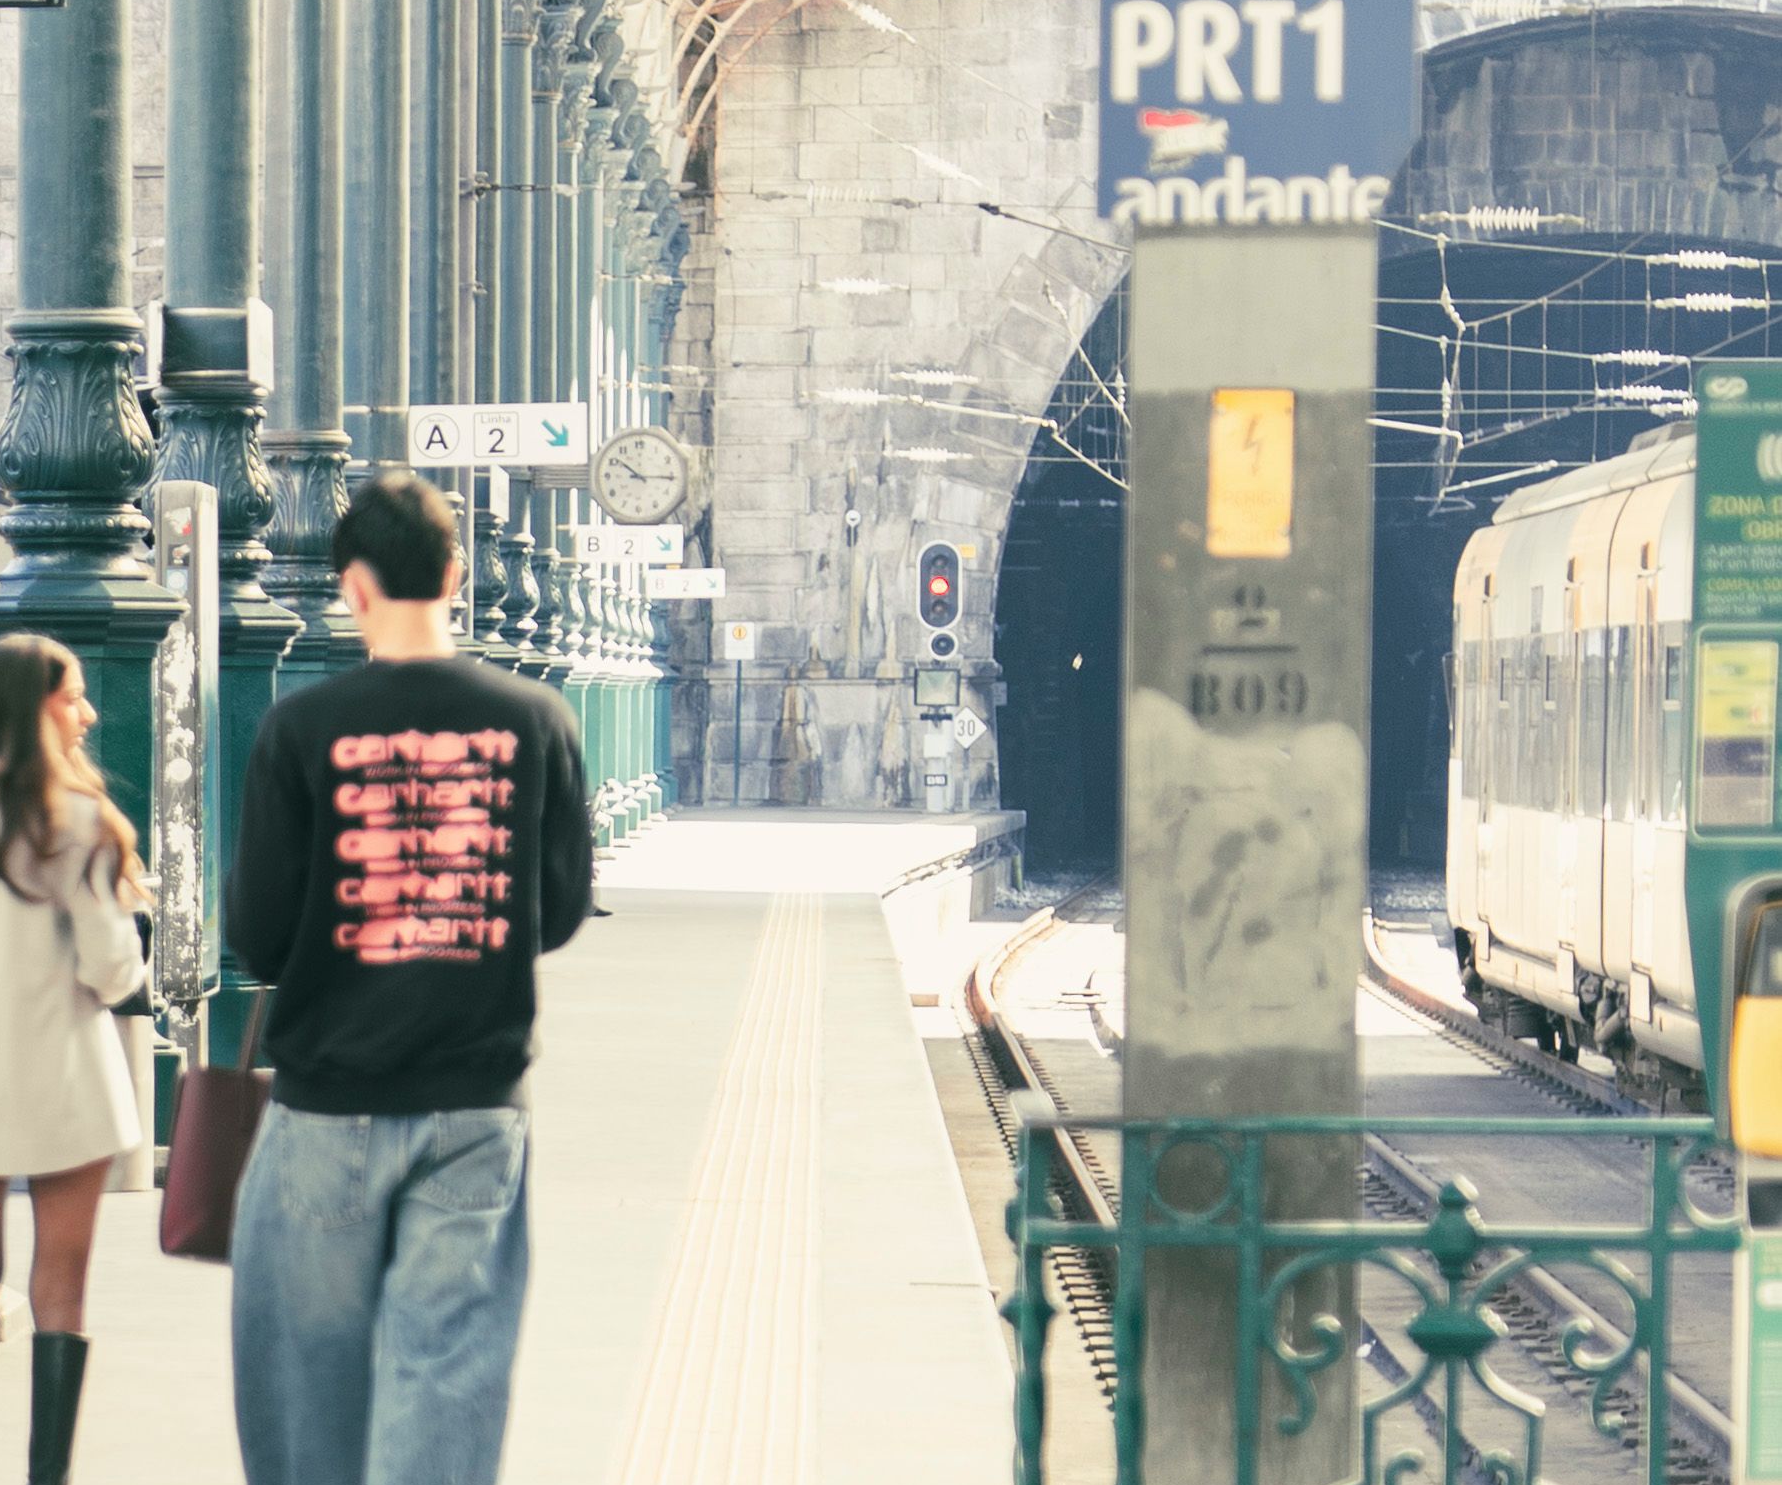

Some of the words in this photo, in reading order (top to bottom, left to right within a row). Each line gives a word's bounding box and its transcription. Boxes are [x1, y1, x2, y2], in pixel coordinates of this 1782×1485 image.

[425, 424, 449, 451] A
[489, 428, 505, 453] 2
[587, 537, 600, 553] B
[623, 540, 635, 556] 2
[957, 720, 976, 737] 30
